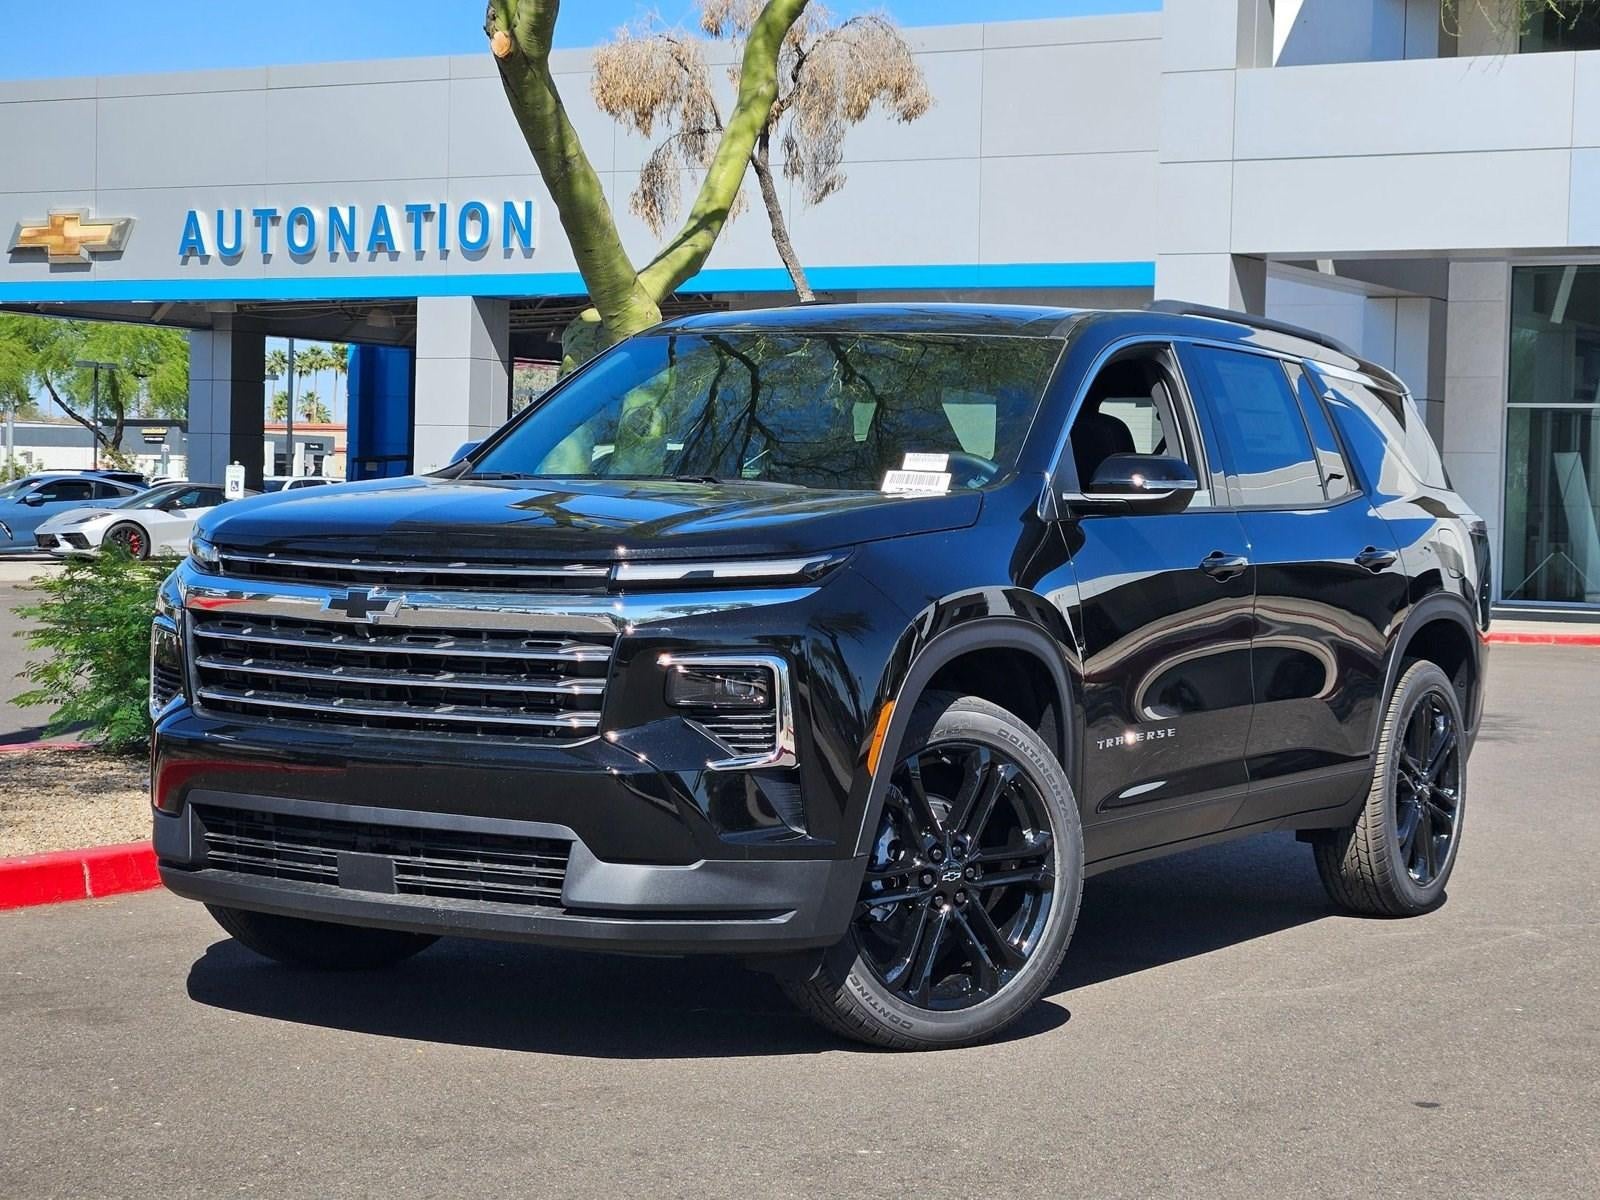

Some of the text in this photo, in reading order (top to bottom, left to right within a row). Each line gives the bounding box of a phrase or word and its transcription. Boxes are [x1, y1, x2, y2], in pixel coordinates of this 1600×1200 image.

[178, 200, 533, 256] AUTONATION
[1096, 727, 1176, 750] TRAERSE
[850, 970, 914, 1030] CONTINE
